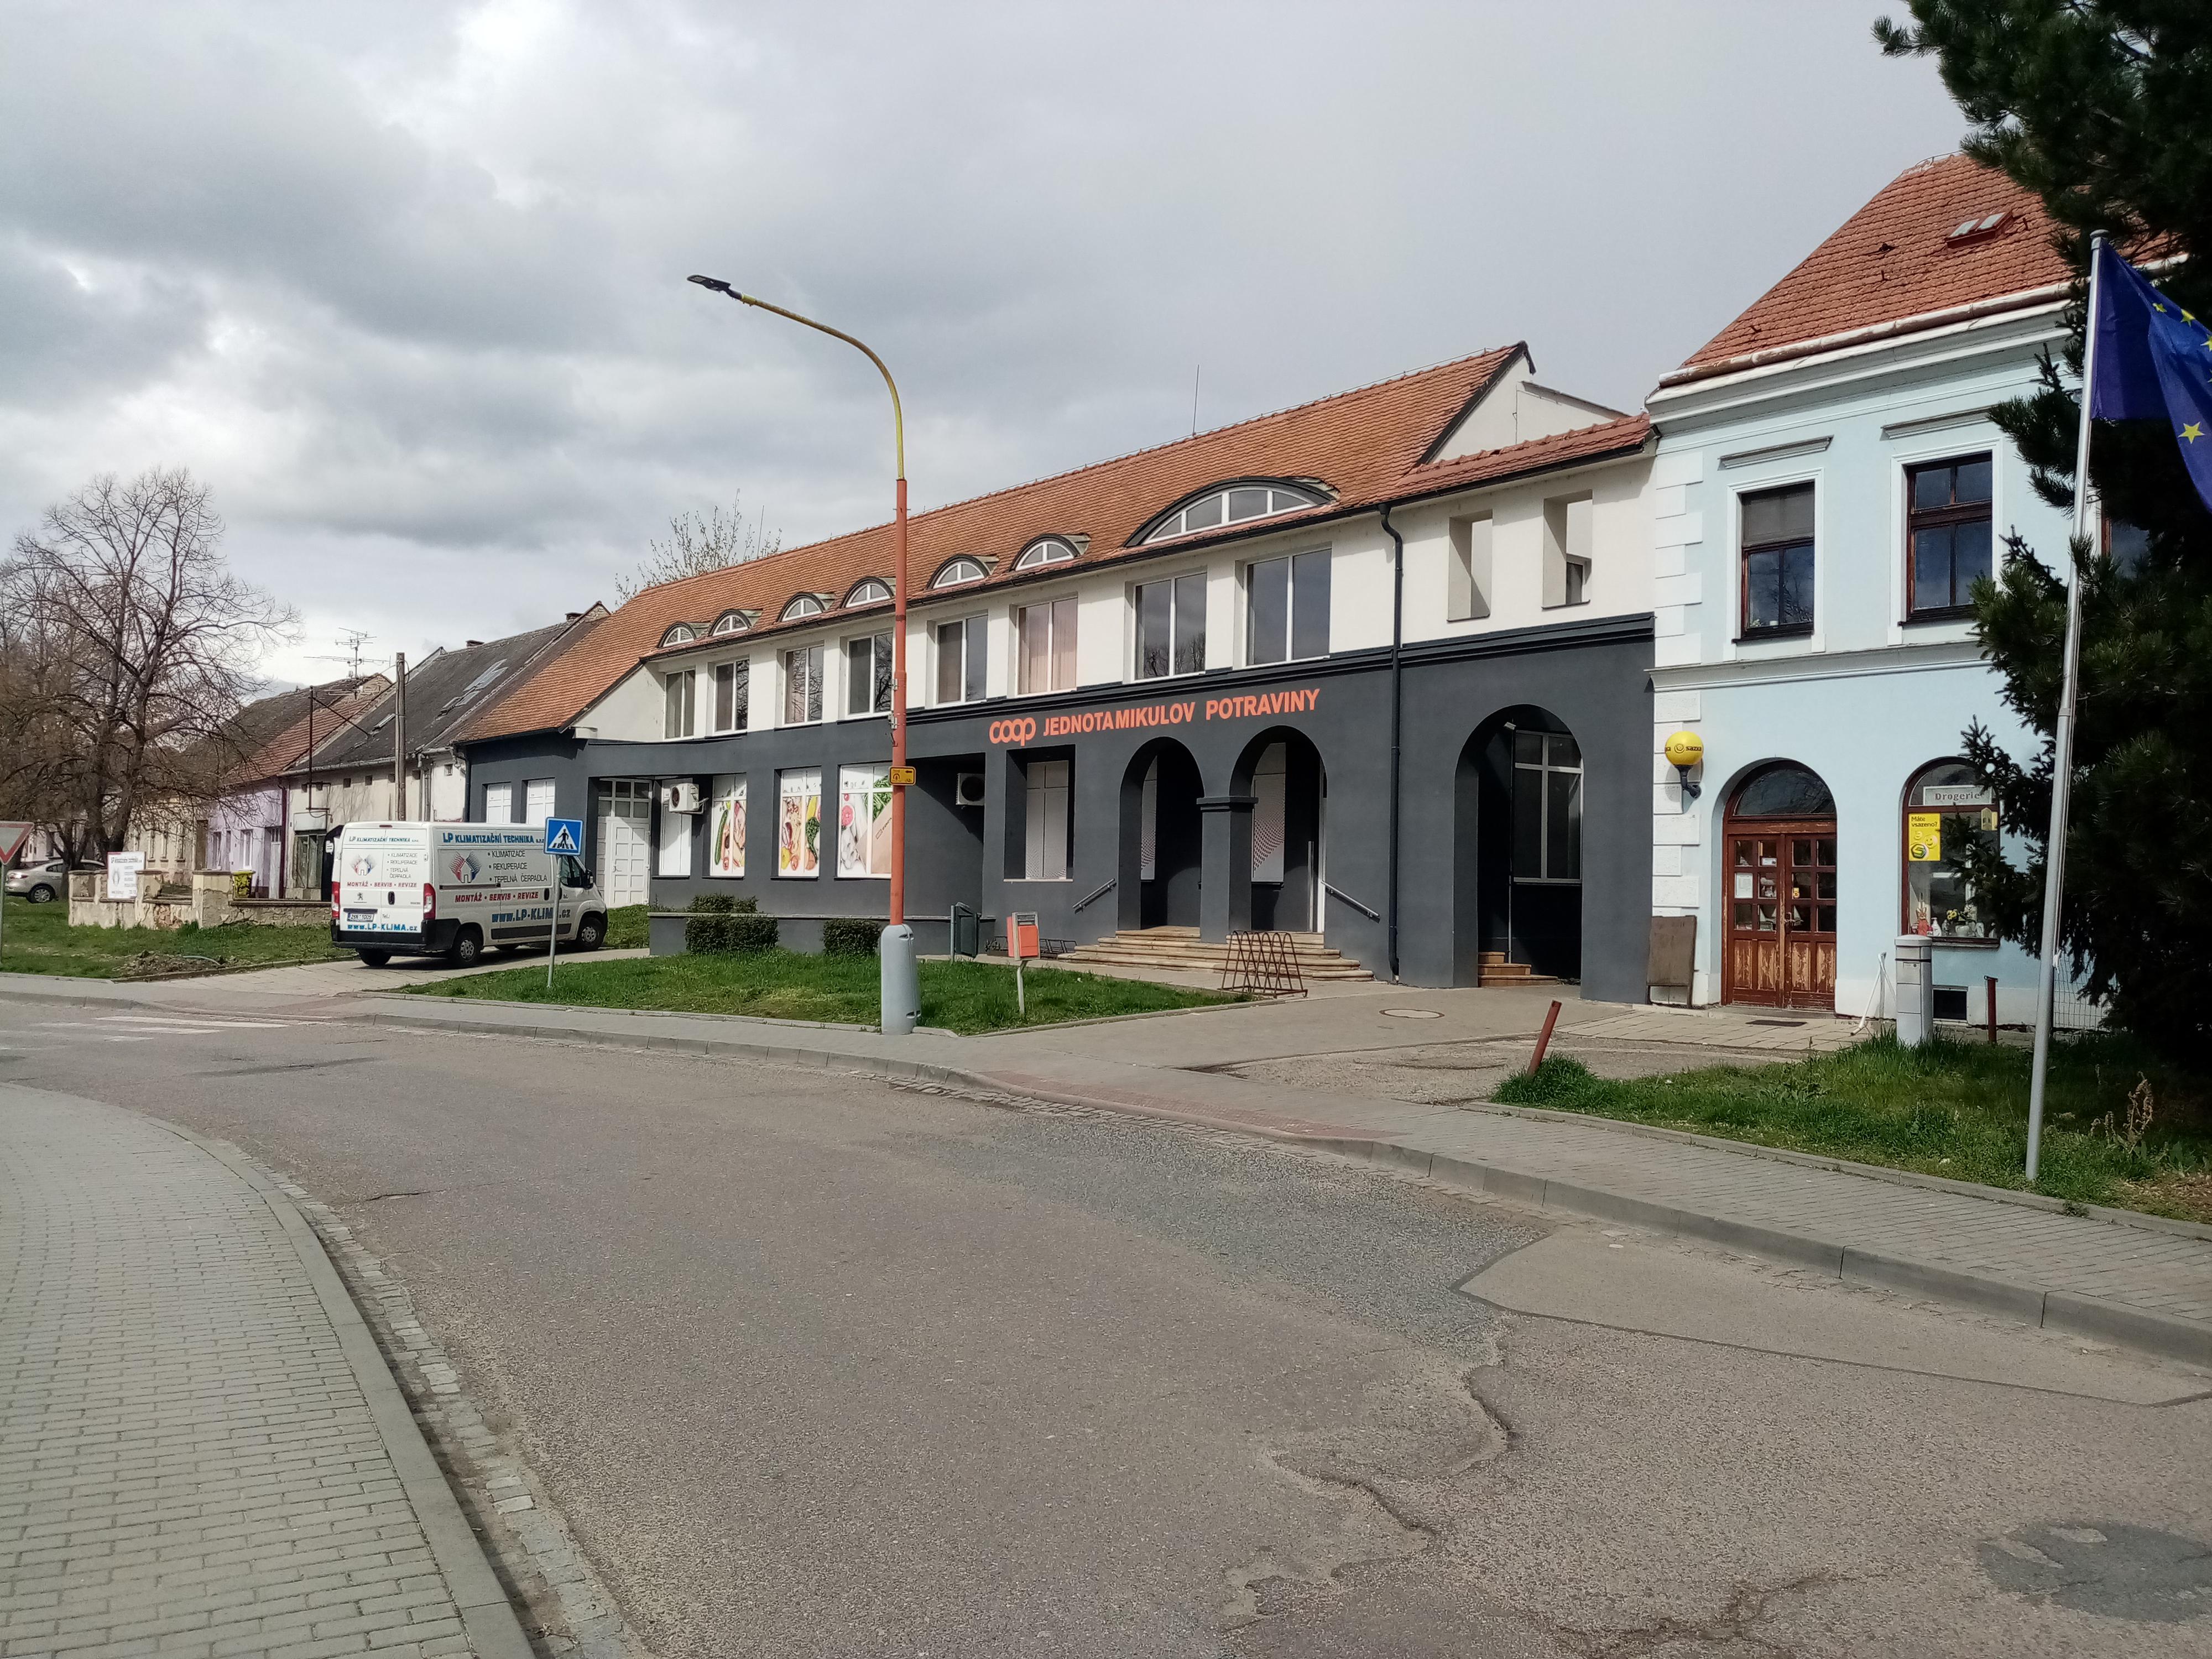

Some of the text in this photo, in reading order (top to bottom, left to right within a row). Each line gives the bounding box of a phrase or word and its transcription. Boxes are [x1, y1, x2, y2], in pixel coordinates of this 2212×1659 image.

[989, 717, 1036, 747] coop
[1206, 688, 1321, 721] POTRAVINY
[1935, 792, 1981, 801] Drogerie
[443, 832, 453, 843] LP
[455, 832, 502, 843] KLIMATIZAČNÍ
[503, 834, 534, 843] TECHNIKA
[494, 873, 547, 883] TEPELNÁ ČERPADLA
[455, 891, 539, 902] MONTÁŽ SERVIS REVIZE
[492, 907, 571, 923] www.LP-KLIM.cz
[347, 923, 418, 931] www.LP-KLIMA.cz
